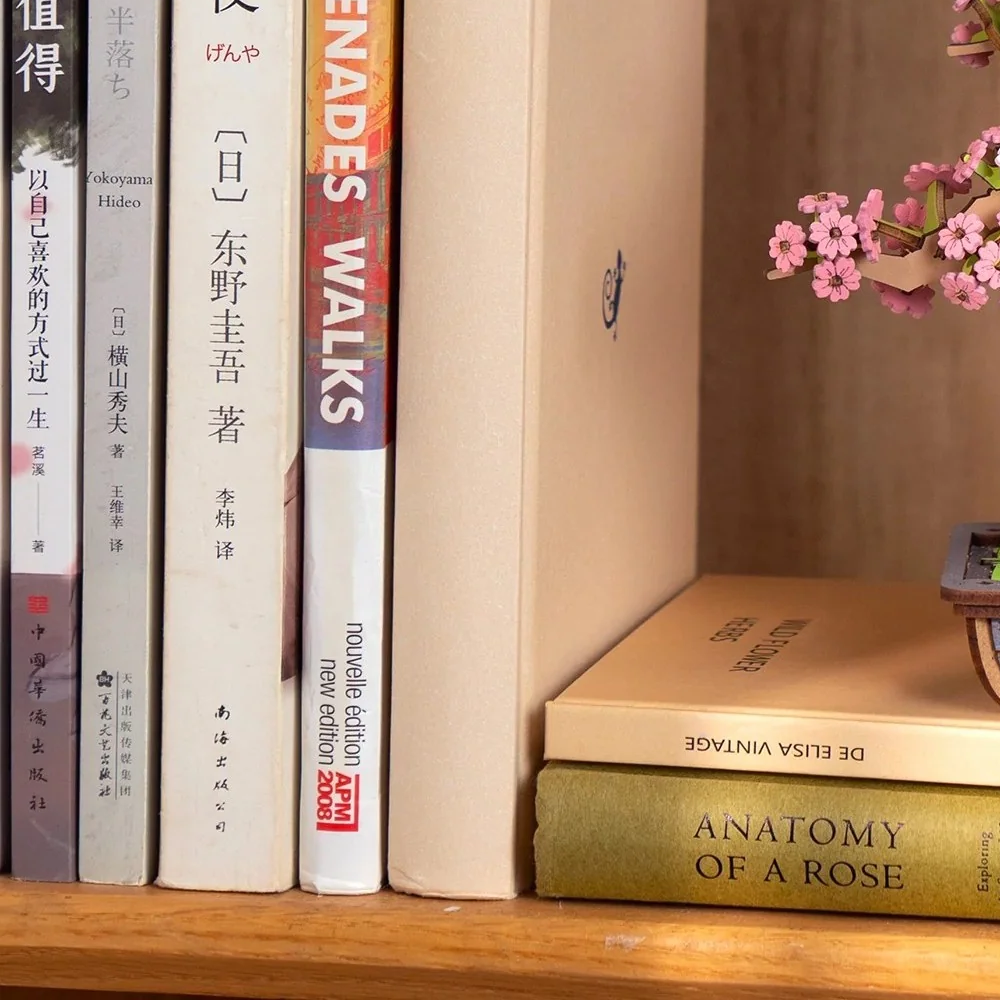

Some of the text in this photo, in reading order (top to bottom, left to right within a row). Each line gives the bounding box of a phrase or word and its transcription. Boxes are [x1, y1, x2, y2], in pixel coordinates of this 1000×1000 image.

[206, 43, 260, 64] げんや
[85, 171, 153, 188] Yokoyama
[98, 195, 141, 208] Hideo
[27, 169, 51, 430] 以自己喜欢的方式过一生
[209, 230, 247, 384] 东野圭吾
[320, 238, 366, 425] WALKS
[107, 345, 129, 434] 横山秀夫
[208, 405, 246, 444] 著
[214, 488, 236, 561] 李炜 译
[709, 617, 760, 643] HERBS
[729, 639, 790, 672] FLOWER
[318, 659, 340, 765] new edition
[344, 622, 367, 766] nouvelle édition
[685, 737, 864, 761] DE ELISA VINTAGE
[317, 770, 333, 820] 2008
[334, 772, 351, 821] APM
[693, 812, 905, 850] ANATOMY
[695, 854, 904, 890] OF A ROSE
[977, 832, 993, 892] Exploring
